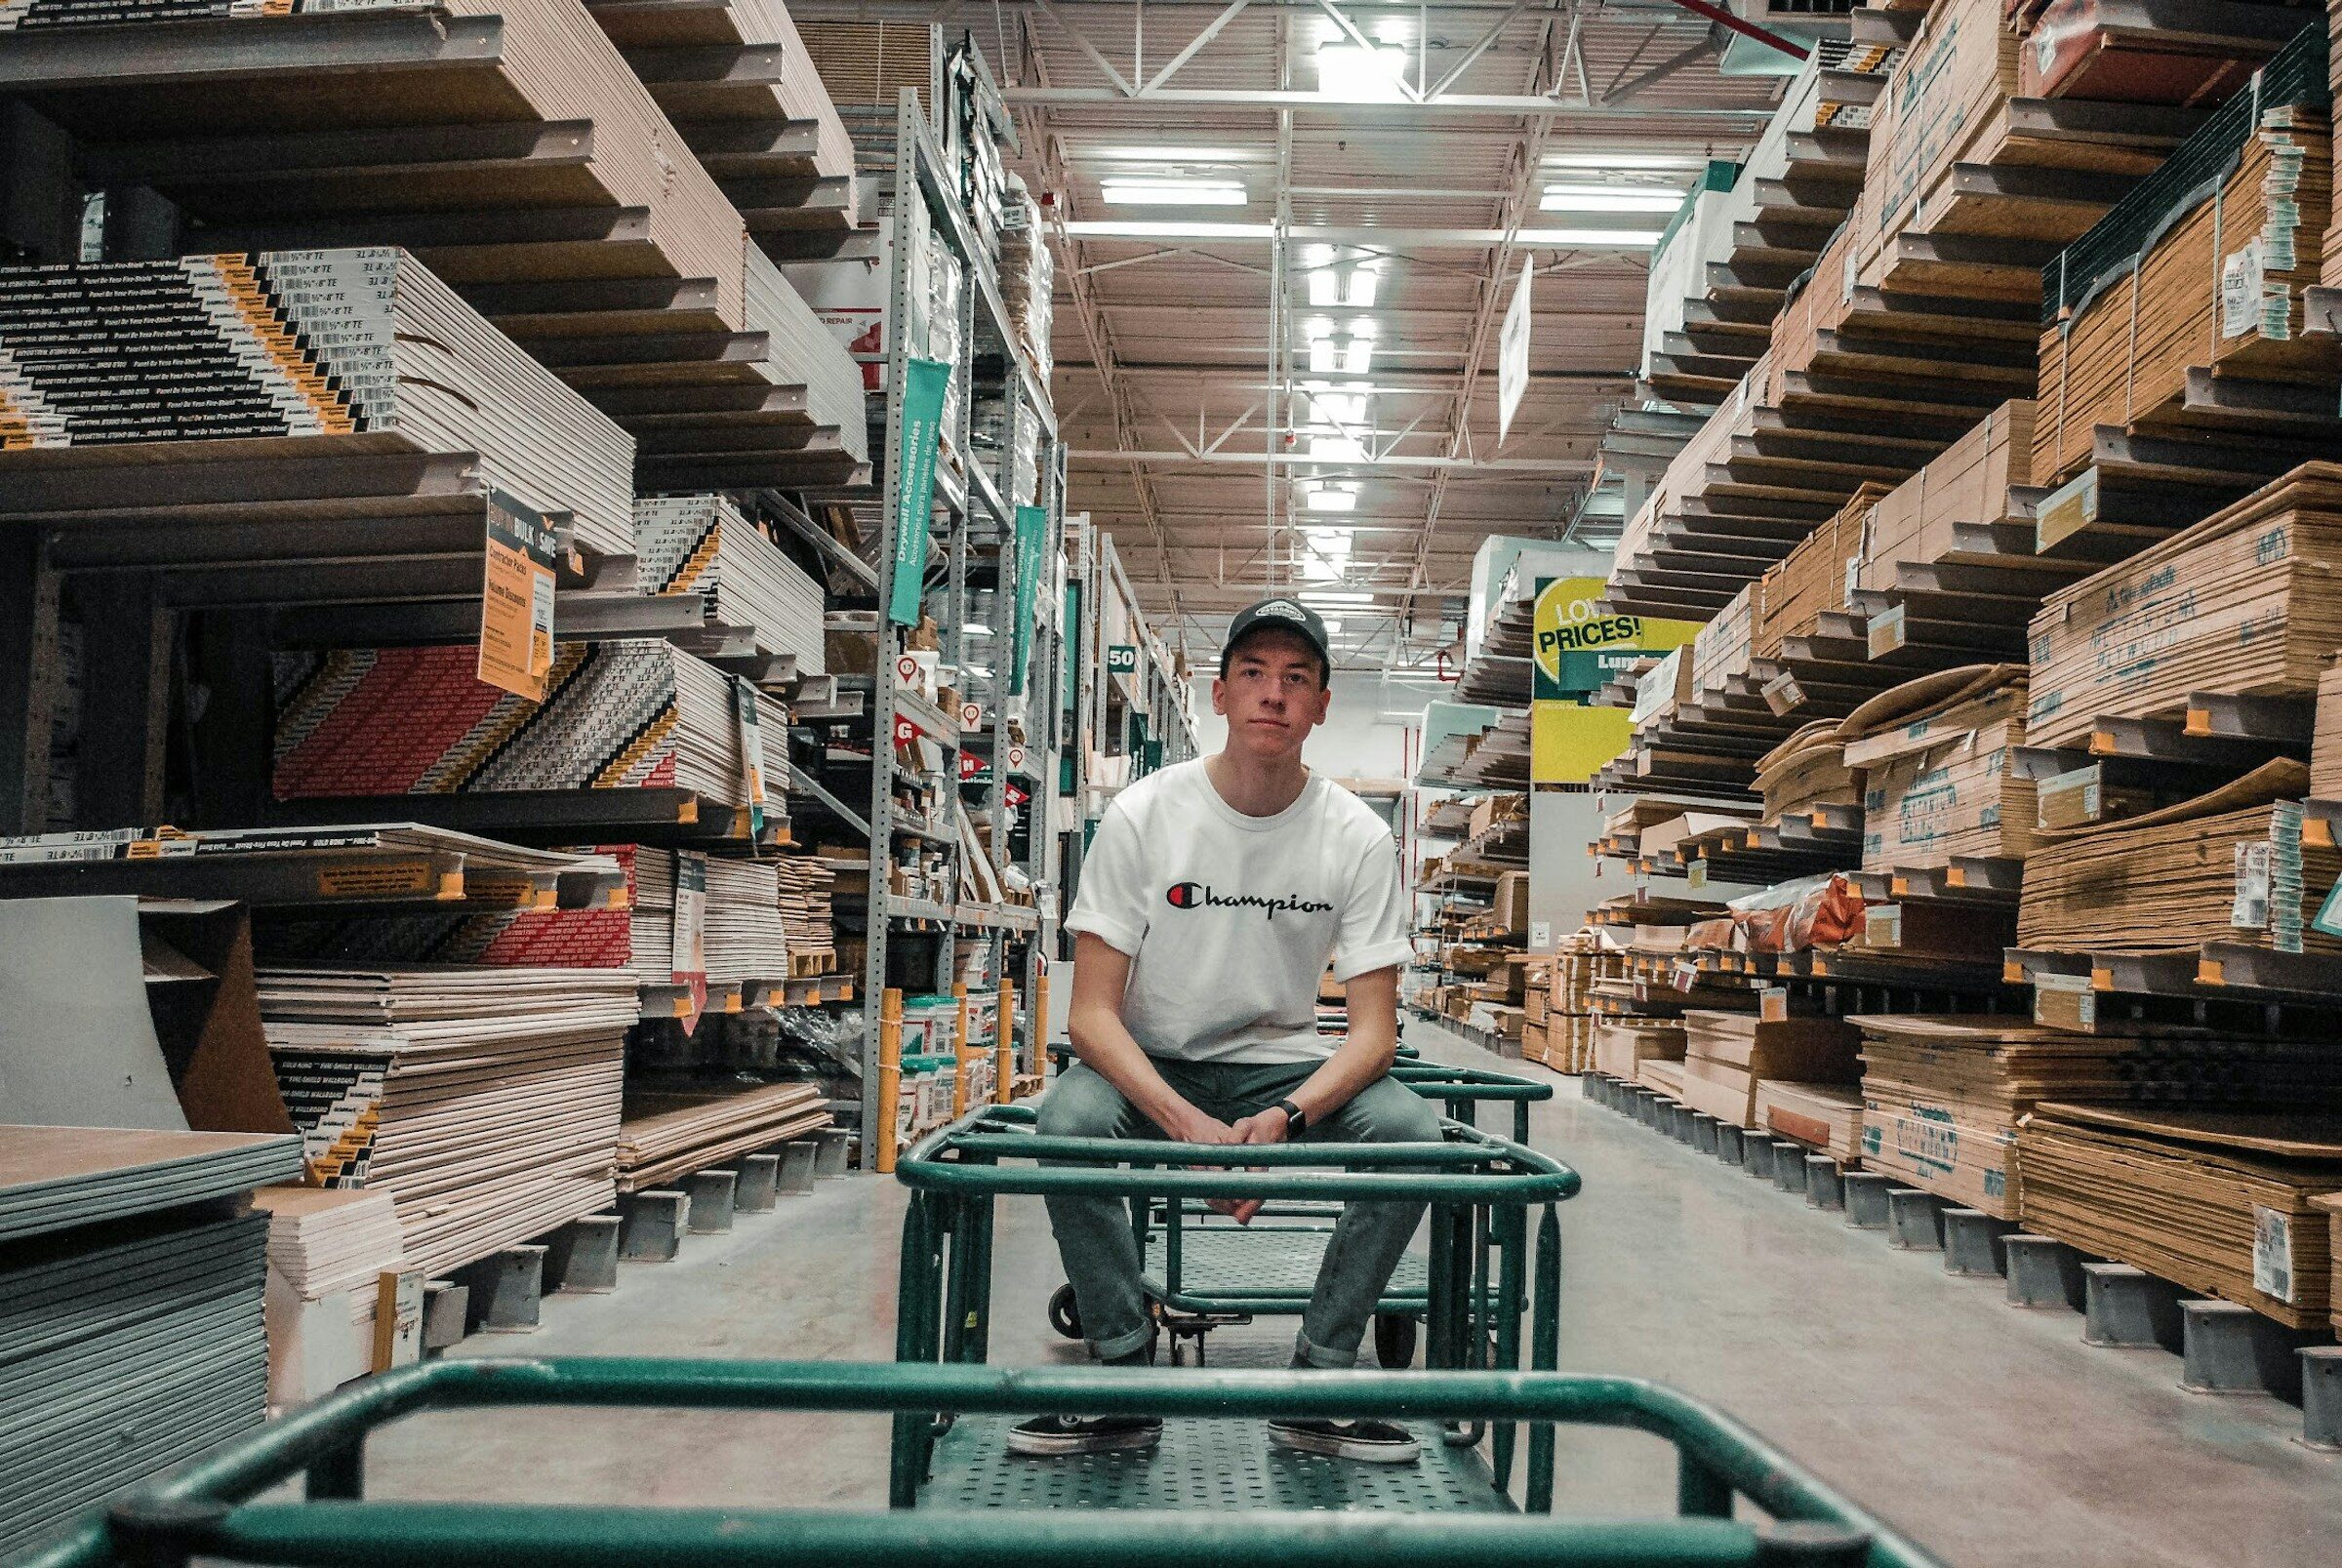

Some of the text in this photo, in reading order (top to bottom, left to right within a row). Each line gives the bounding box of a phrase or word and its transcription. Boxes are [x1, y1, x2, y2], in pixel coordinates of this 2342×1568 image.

[898, 420, 921, 563] Drywall Accessories
[909, 421, 937, 567] Accesorios para paneles de yeso
[514, 516, 535, 546] BULK
[539, 532, 557, 559] SAVE
[1538, 616, 1641, 654] PRICES!
[1109, 650, 1135, 665] 50
[897, 722, 912, 740] G
[963, 760, 974, 771] H
[1166, 881, 1334, 920] Champion
